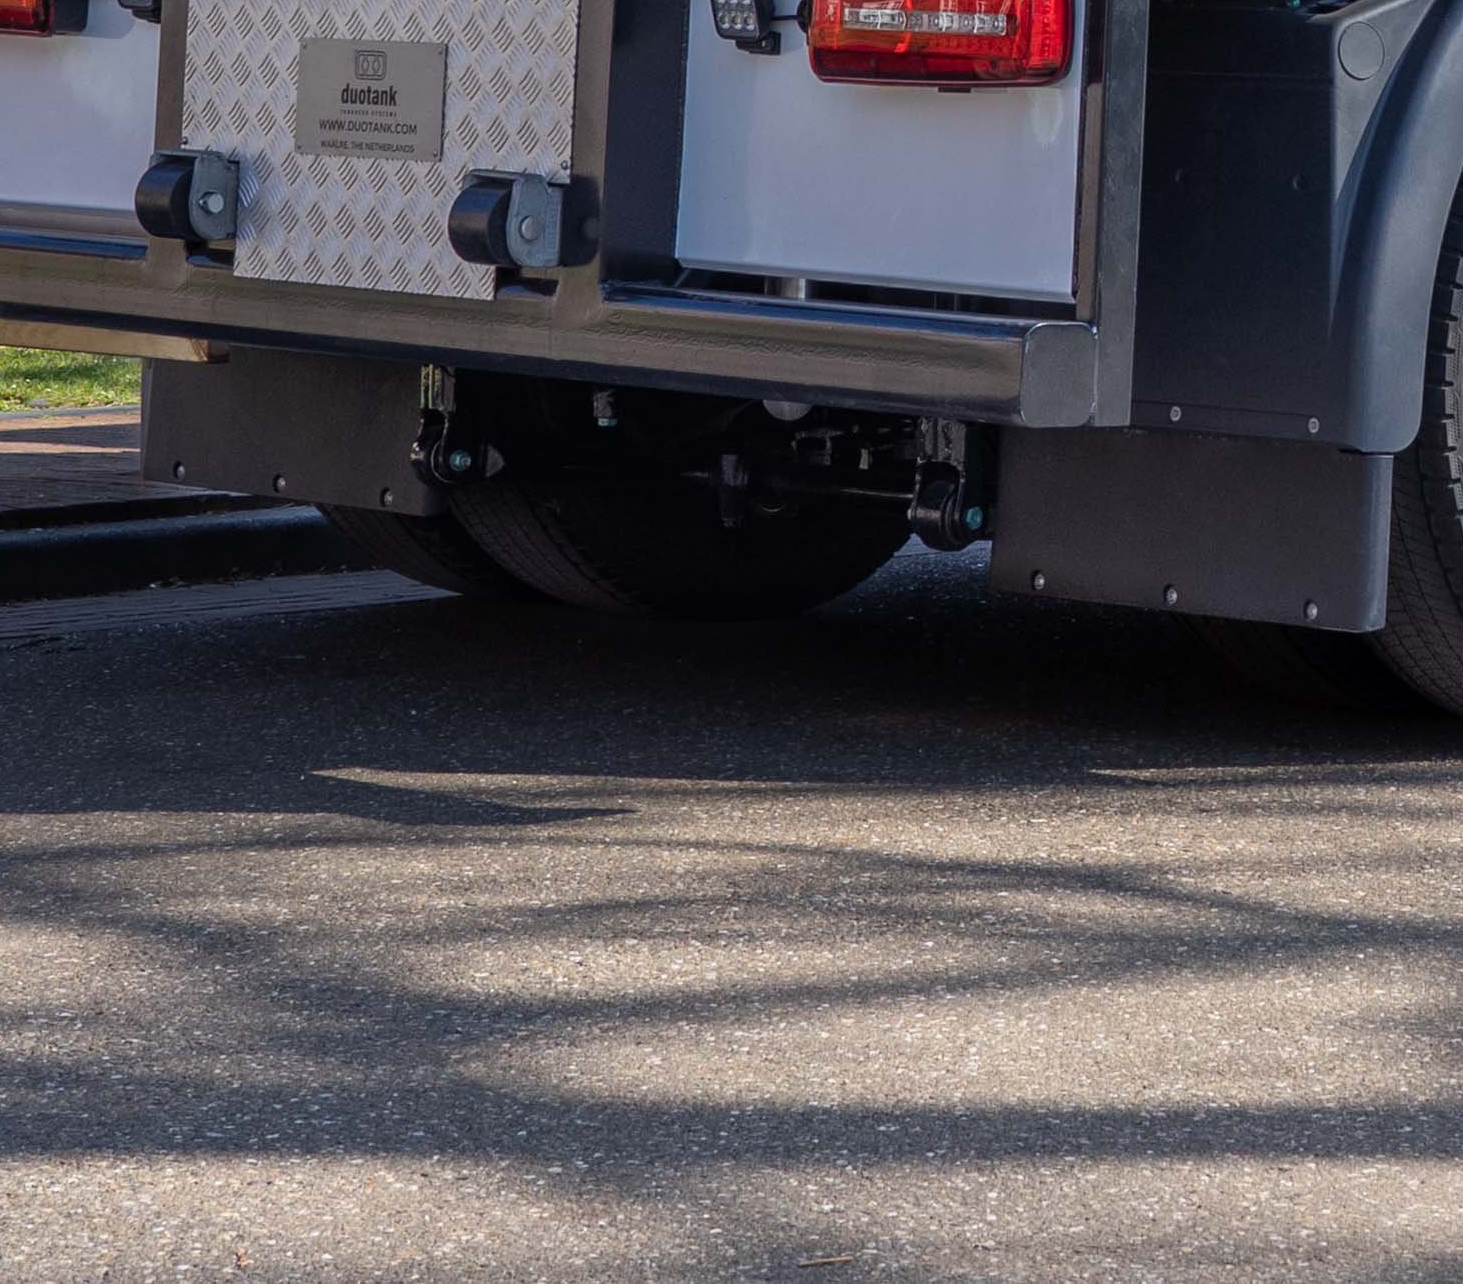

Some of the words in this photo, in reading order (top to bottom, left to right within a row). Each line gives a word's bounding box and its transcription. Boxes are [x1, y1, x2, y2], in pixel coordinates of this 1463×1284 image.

[341, 83, 397, 107] duotank
[319, 119, 417, 135] WWW.DUOTANK.COM
[351, 141, 363, 150] THE
[365, 142, 415, 154] NETHERLANDS
